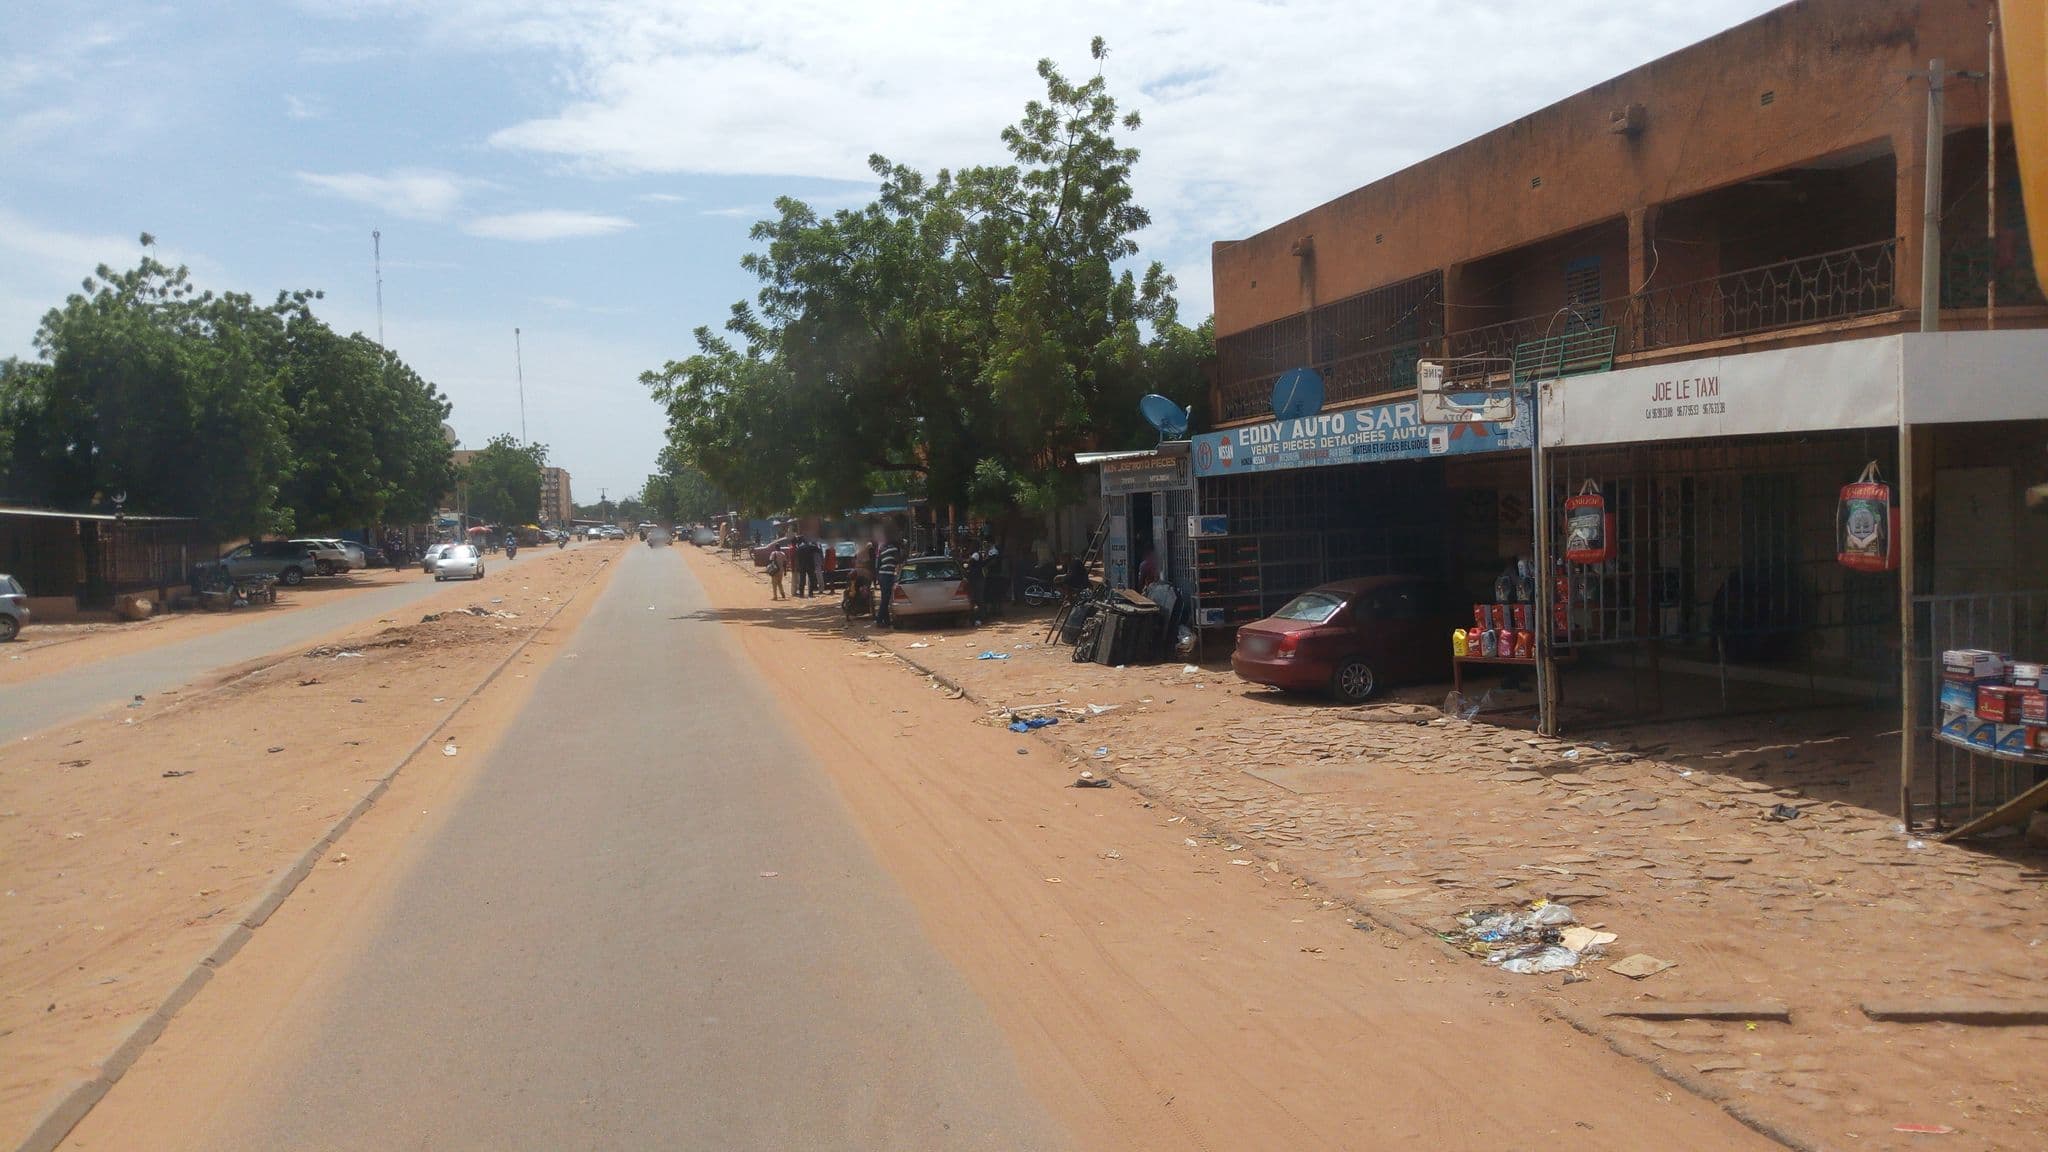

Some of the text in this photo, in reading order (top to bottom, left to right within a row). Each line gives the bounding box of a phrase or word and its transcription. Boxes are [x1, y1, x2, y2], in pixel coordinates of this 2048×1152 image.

[1652, 376, 1719, 402] JOE LE TAXI
[1239, 422, 1283, 446] EDDY
[1292, 414, 1345, 439] AUTO
[1251, 426, 1427, 455] VENTE PIECES DETACHEES AUTO
[1218, 445, 1234, 460] NISSAN
[1353, 443, 1371, 455] MOTEUR
[1372, 442, 1379, 454] ET
[1380, 441, 1399, 453] PIECES
[1400, 439, 1428, 451] BELGIQUE
